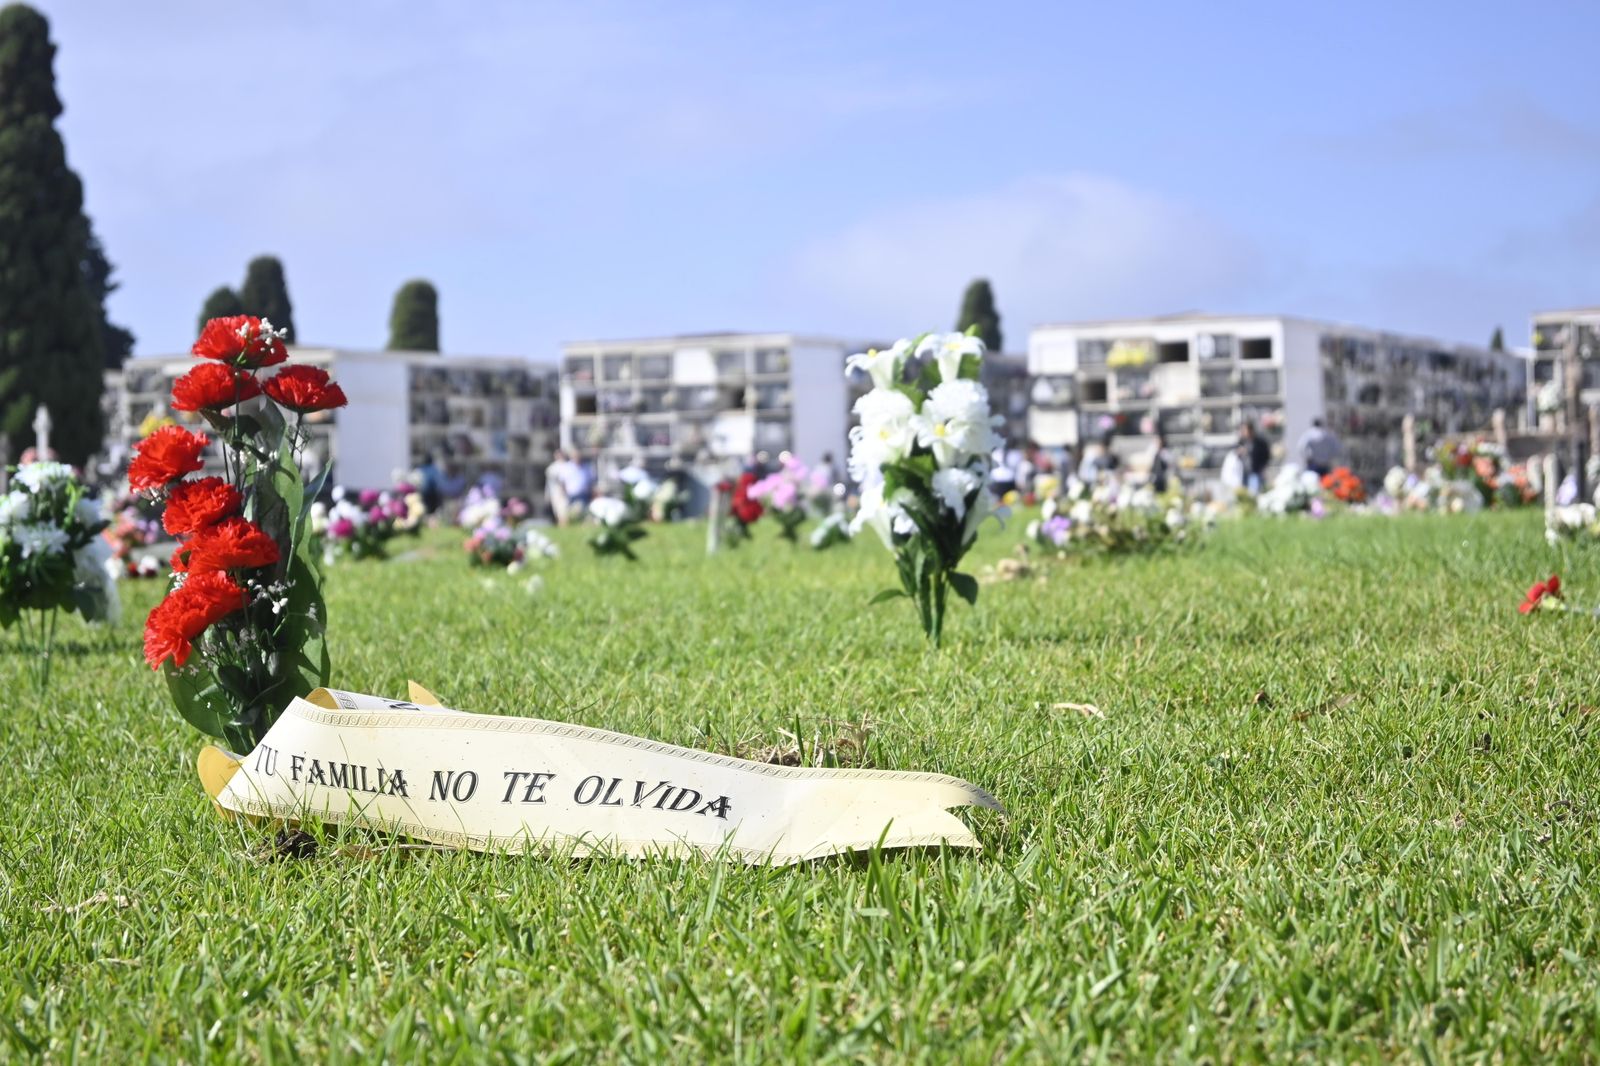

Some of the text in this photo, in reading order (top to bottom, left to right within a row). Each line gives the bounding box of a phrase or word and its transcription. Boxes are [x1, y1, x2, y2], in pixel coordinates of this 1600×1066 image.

[254, 743, 732, 820] TU FAMILIA NO TE OLVIDA
